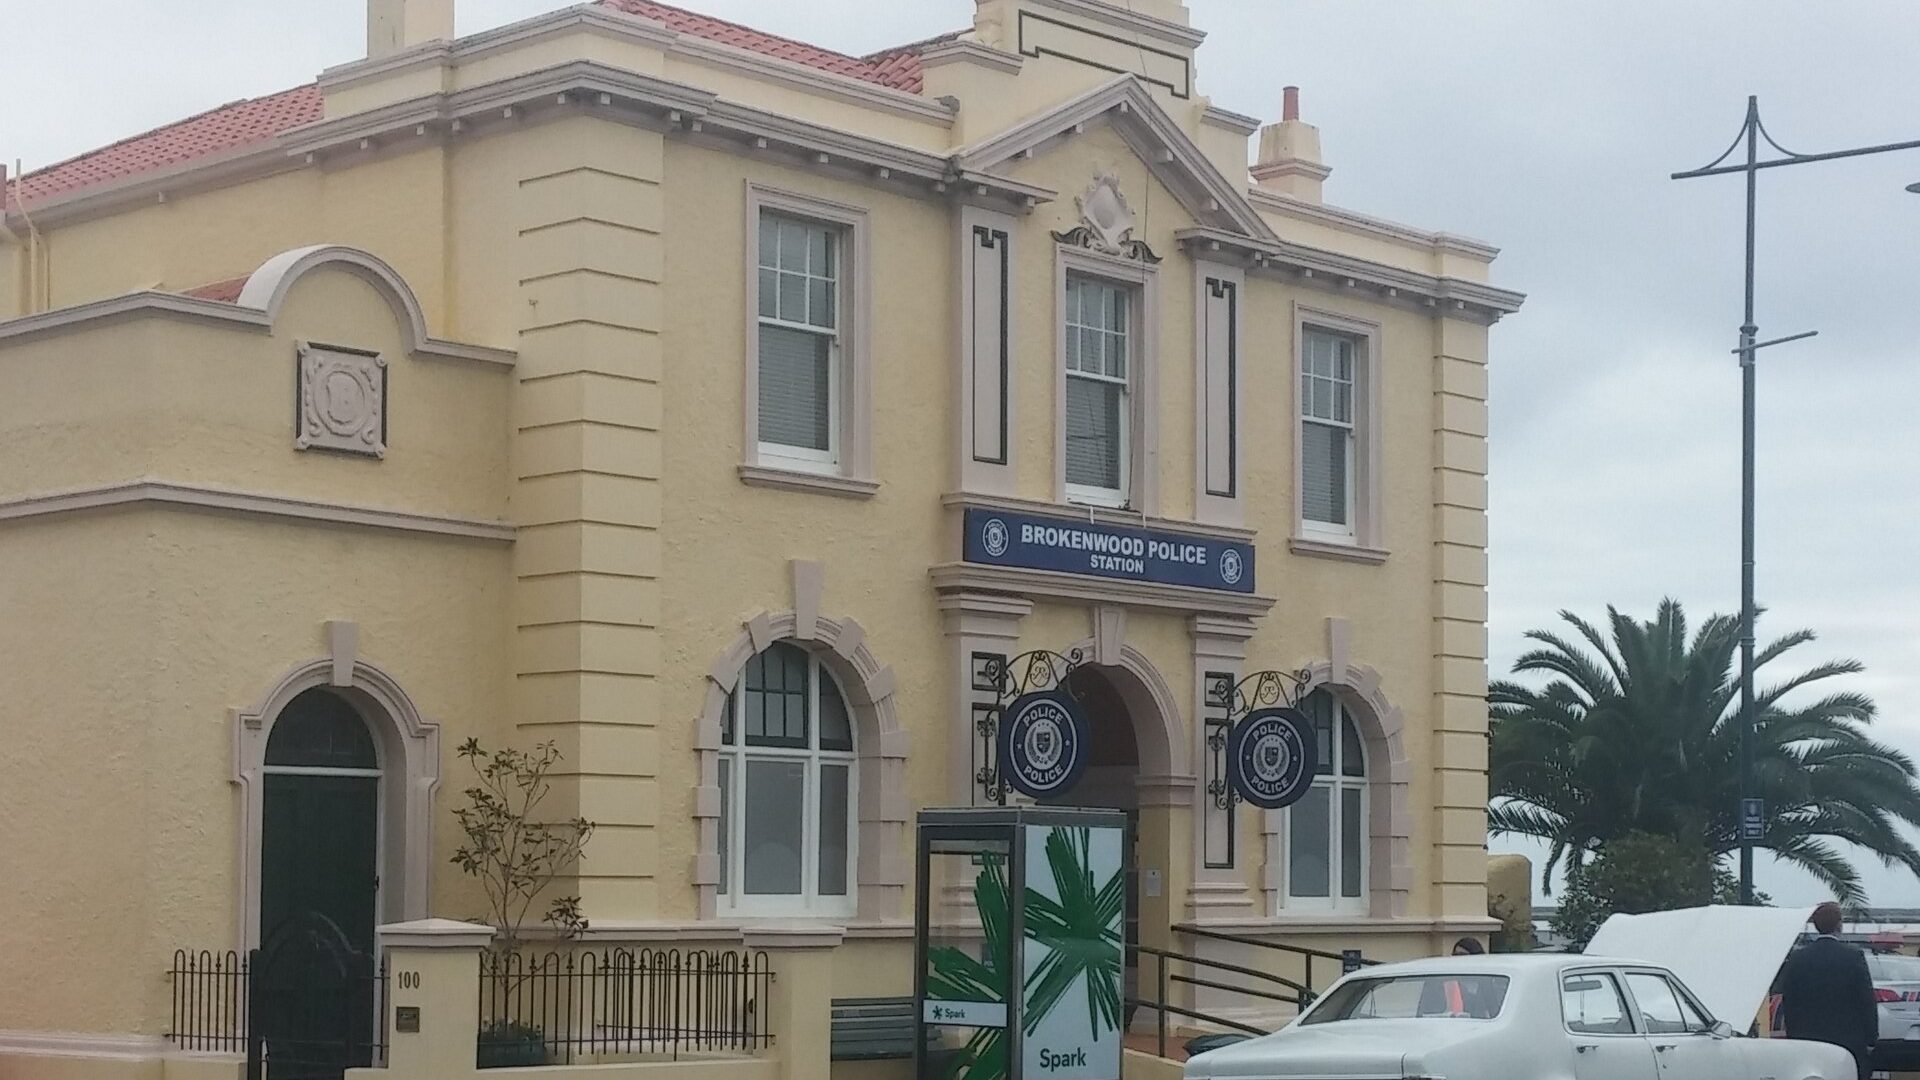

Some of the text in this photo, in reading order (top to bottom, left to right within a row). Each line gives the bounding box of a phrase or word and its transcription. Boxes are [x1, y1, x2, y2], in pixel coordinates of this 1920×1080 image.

[1021, 524, 1206, 564] BROKENWOOD POLICE
[1090, 554, 1144, 574] STATION
[1023, 706, 1064, 727] POLICE
[1252, 723, 1293, 742] POLICE
[1023, 764, 1063, 783] POLICE
[1250, 775, 1290, 794] POLICE
[398, 971, 420, 989] 100
[945, 1007, 965, 1020] Spark
[1039, 1047, 1087, 1072] Spark
